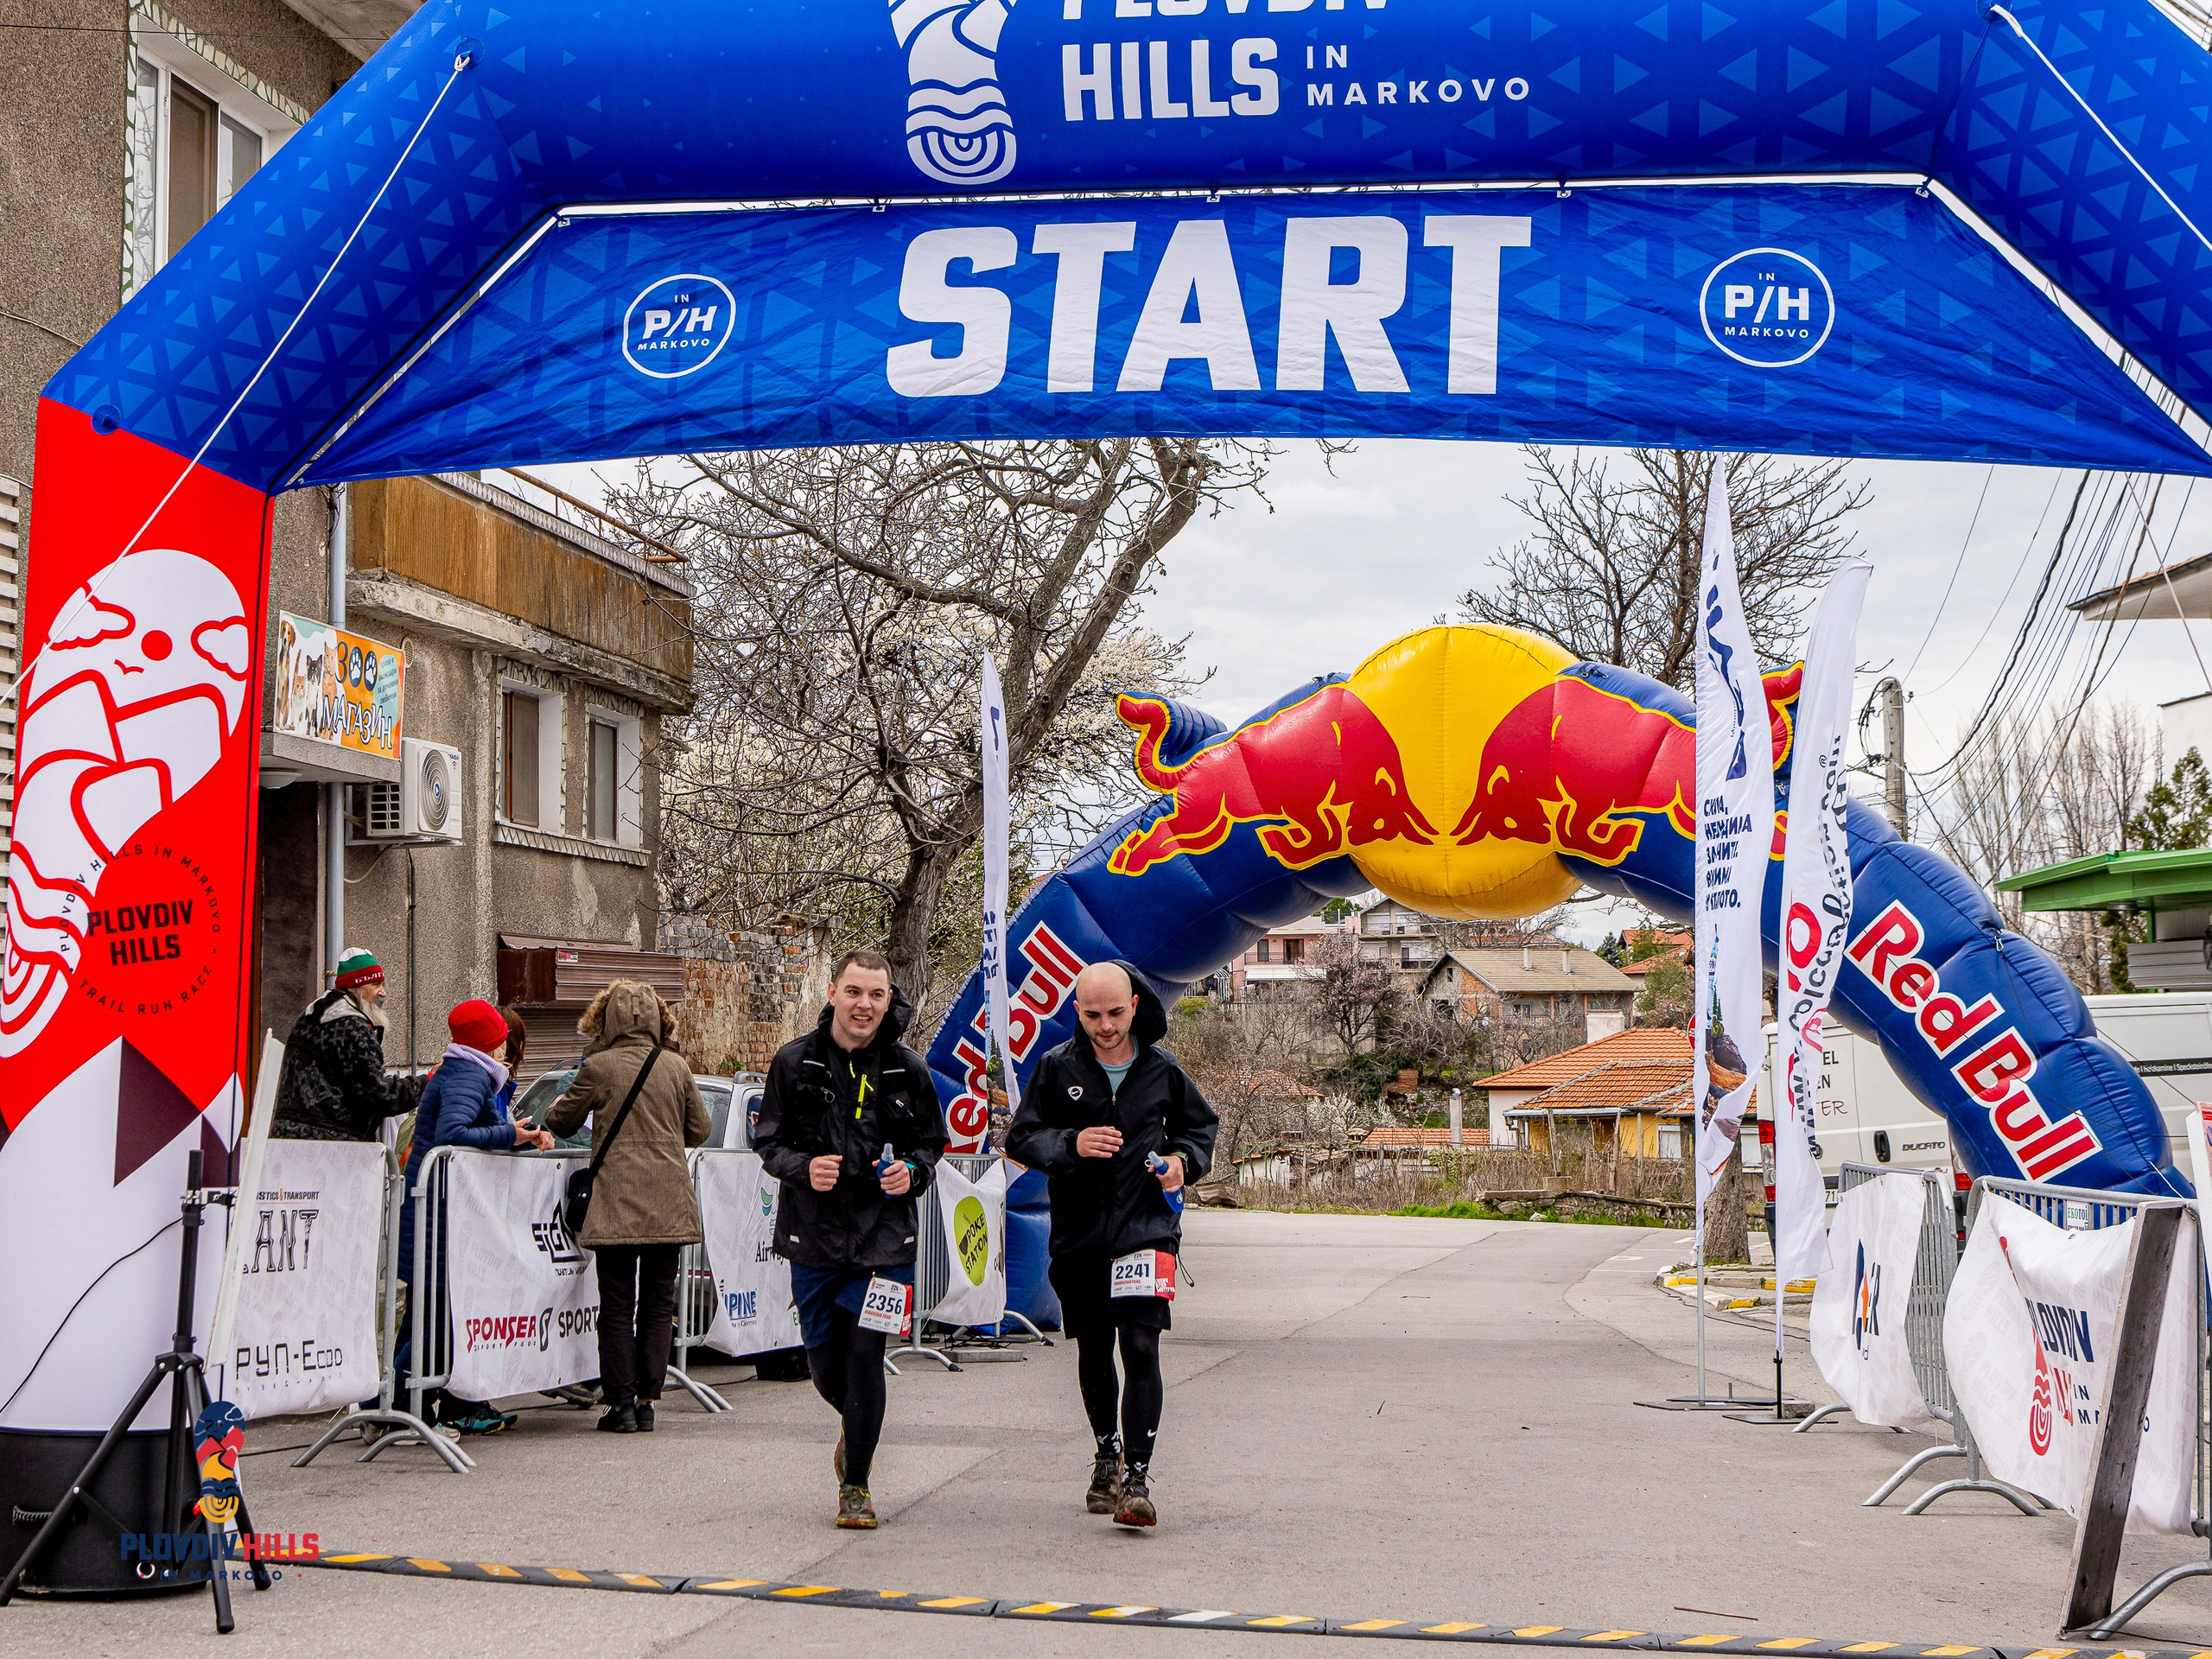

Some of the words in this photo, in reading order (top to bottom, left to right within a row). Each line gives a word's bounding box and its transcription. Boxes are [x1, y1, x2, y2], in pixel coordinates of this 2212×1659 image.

[1306, 44, 1349, 69] IN
[1061, 37, 1280, 122] HILLS
[1306, 77, 1530, 106] MARKOVO
[1758, 272, 1775, 282] IN
[674, 294, 690, 302] IN
[887, 215, 1532, 398] START
[1725, 284, 1809, 323] P/H
[642, 306, 717, 340] P/H
[1725, 327, 1809, 339] MARKOVO
[638, 339, 710, 351] MARKOVO
[321, 695, 393, 750] МАГАЗИН
[60, 873, 87, 952] PLOVDIV
[90, 843, 143, 873] HILLS
[154, 844, 173, 859] IN
[180, 855, 221, 933] MARKOVO
[87, 899, 194, 938] PLOVDIV
[110, 934, 181, 967] HILLS
[79, 978, 126, 1014] TRAIL
[137, 1000, 173, 1015] RUN
[180, 964, 213, 1003] RACE
[1844, 900, 2004, 1058] Red
[1952, 1027, 2102, 1183] Bull
[1902, 1141, 1946, 1152] DUCATO
[283, 1191, 320, 1200] TRANSPORT
[242, 1210, 319, 1274] ANT
[966, 1212, 985, 1243] POKE
[1115, 1262, 1150, 1280] 2241
[866, 1293, 903, 1314] 2356
[466, 1315, 537, 1354] SPONSER
[2073, 1383, 2090, 1401] IN
